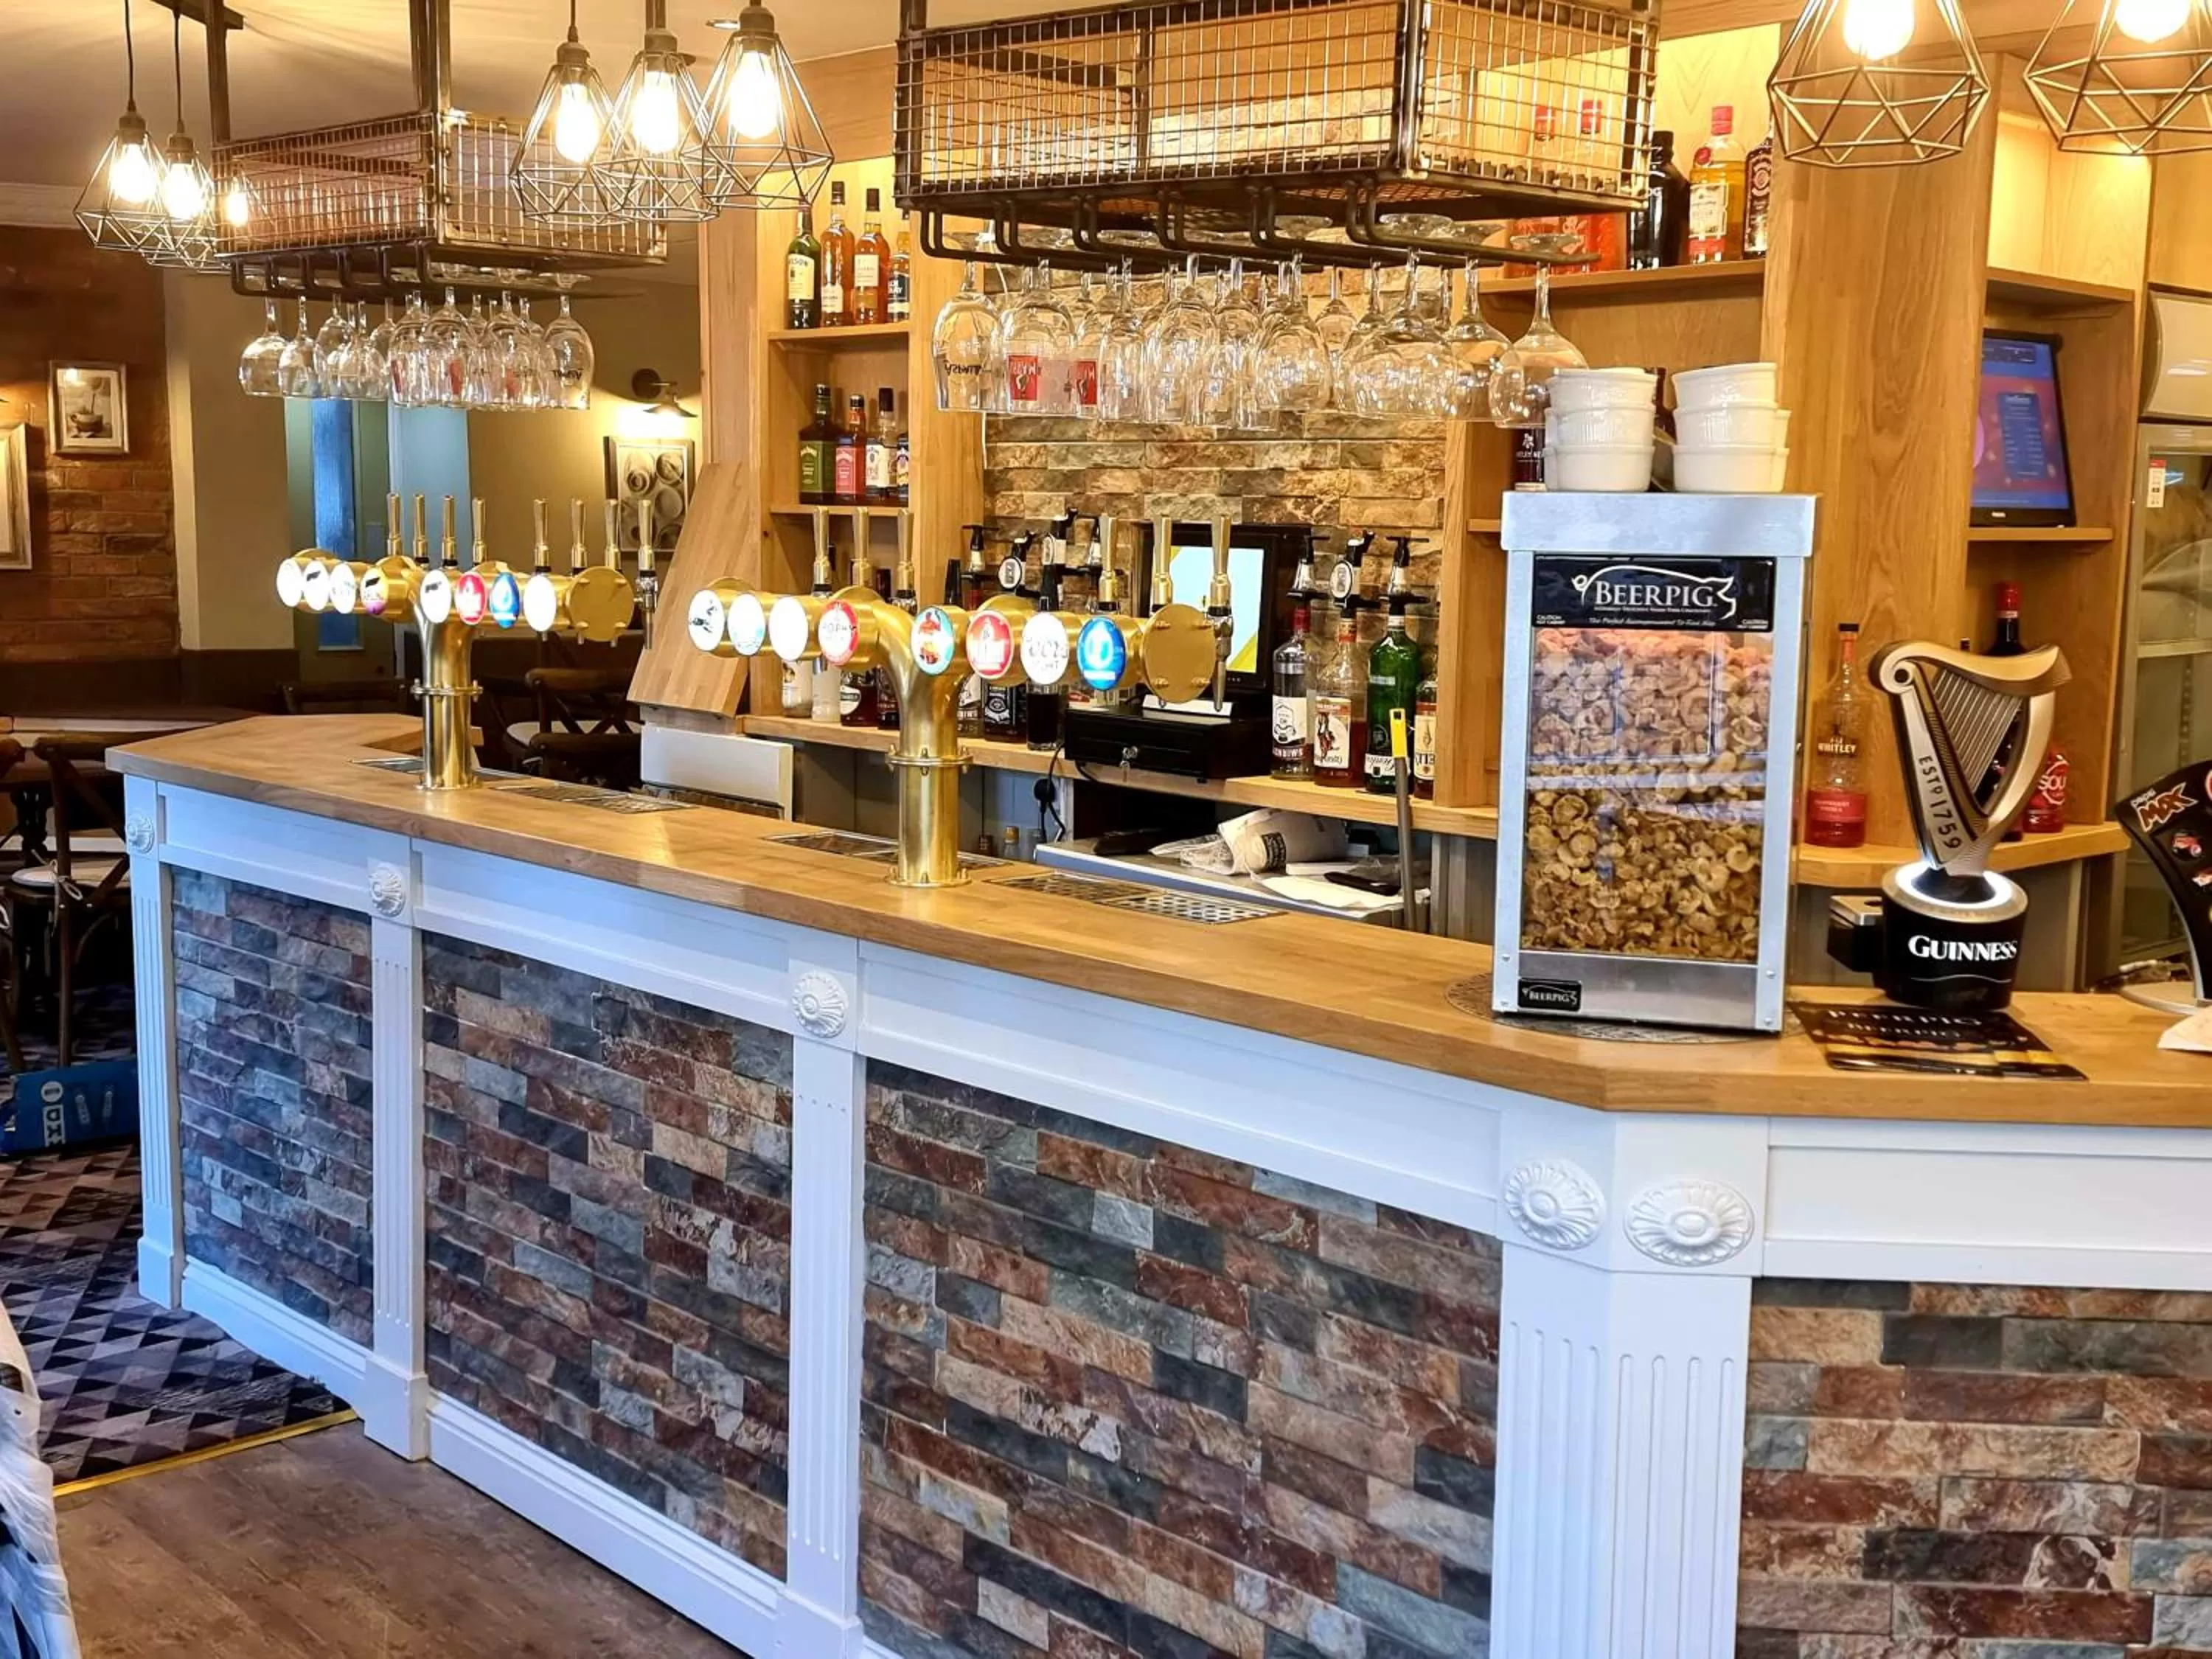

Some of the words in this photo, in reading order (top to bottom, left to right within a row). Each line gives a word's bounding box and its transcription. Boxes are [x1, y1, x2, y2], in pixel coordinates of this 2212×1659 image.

[1595, 580, 1714, 608] BEERPIG
[1930, 799, 1962, 849] 1759
[2138, 782, 2199, 832] MAX
[1907, 934, 2018, 961] GUINNESS
